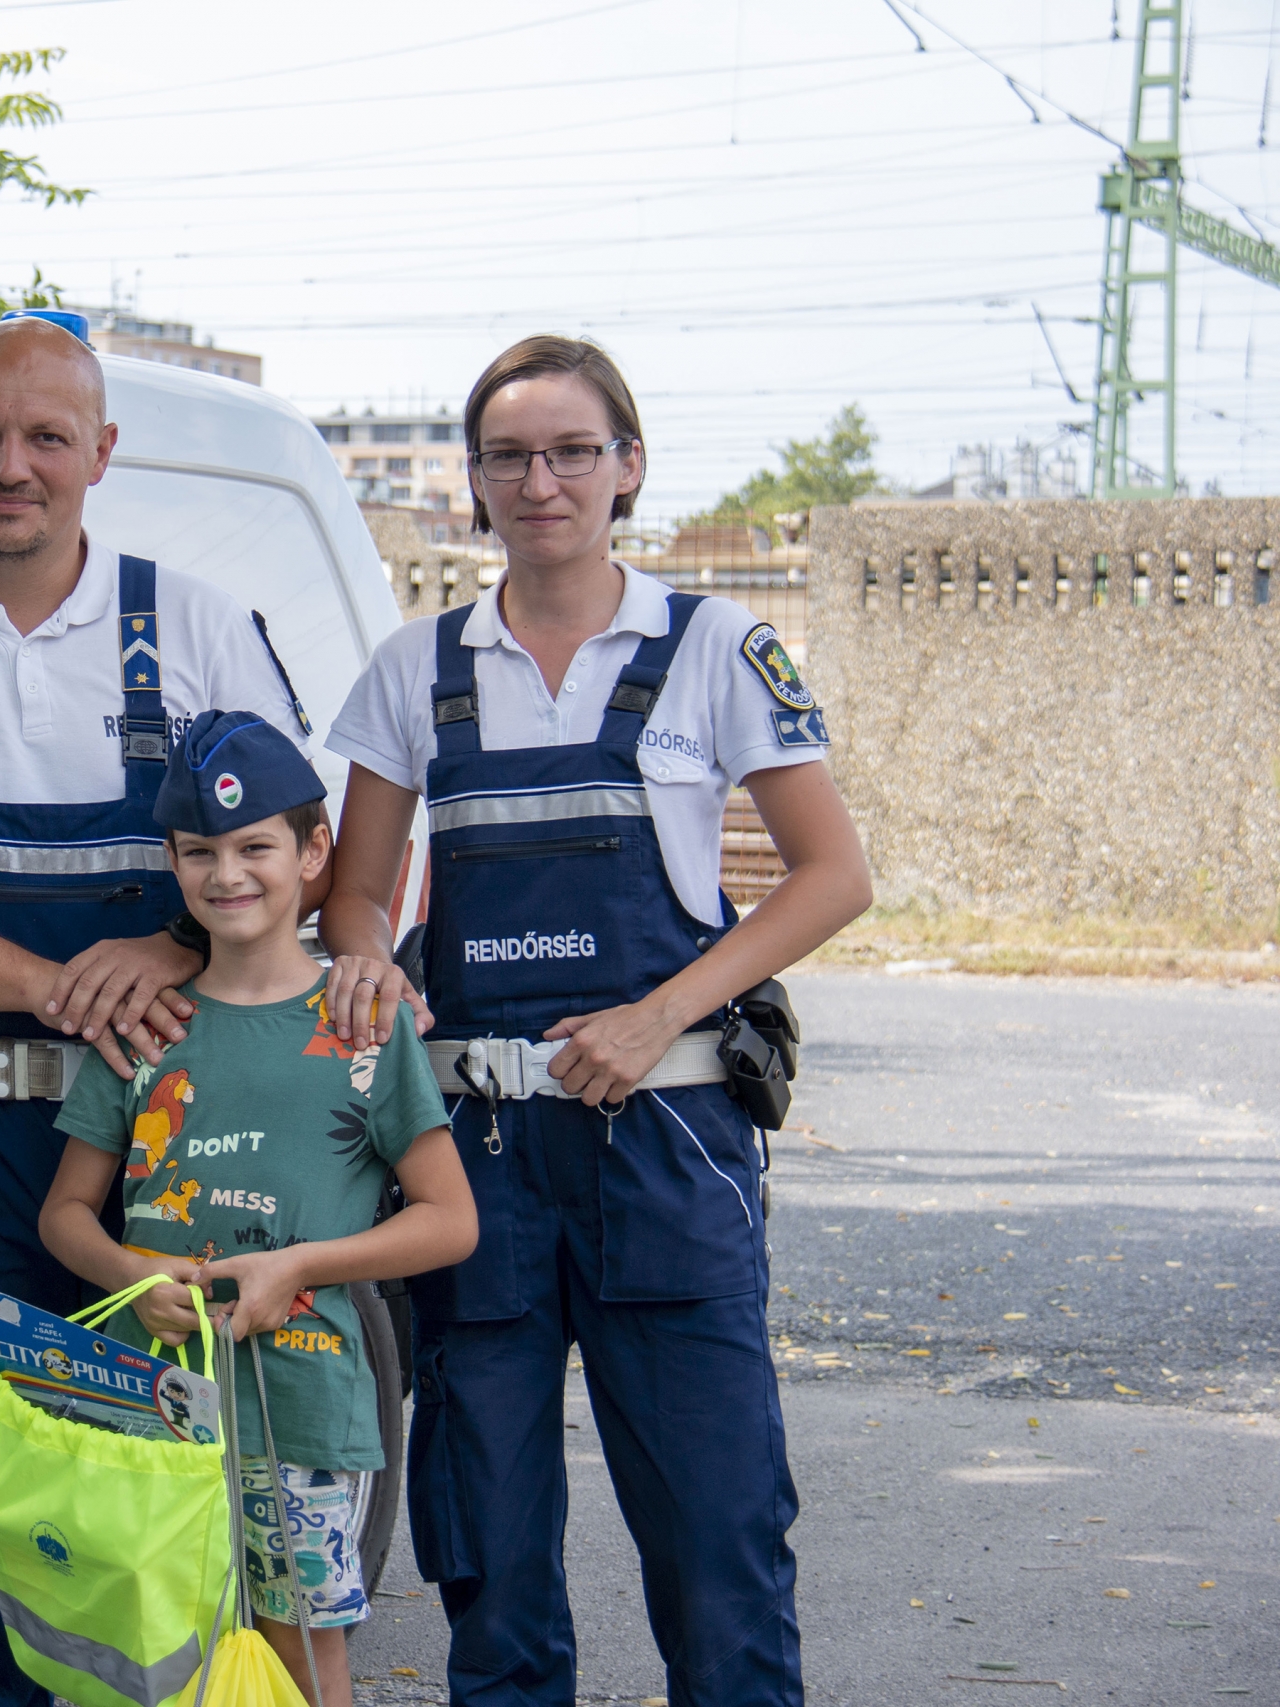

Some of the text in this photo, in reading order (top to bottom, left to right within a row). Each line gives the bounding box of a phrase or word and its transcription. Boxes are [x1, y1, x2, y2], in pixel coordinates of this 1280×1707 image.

[752, 629, 776, 647] POLIC
[464, 929, 596, 964] RENDŐRSÉG
[187, 1131, 265, 1158] DON'T
[209, 1188, 277, 1215] MESS
[283, 1234, 313, 1249] M
[38, 1327, 58, 1337] SAFE
[273, 1329, 343, 1355] PRIDE
[120, 1354, 151, 1370] TOY CAR
[72, 1359, 153, 1398] POLICE
